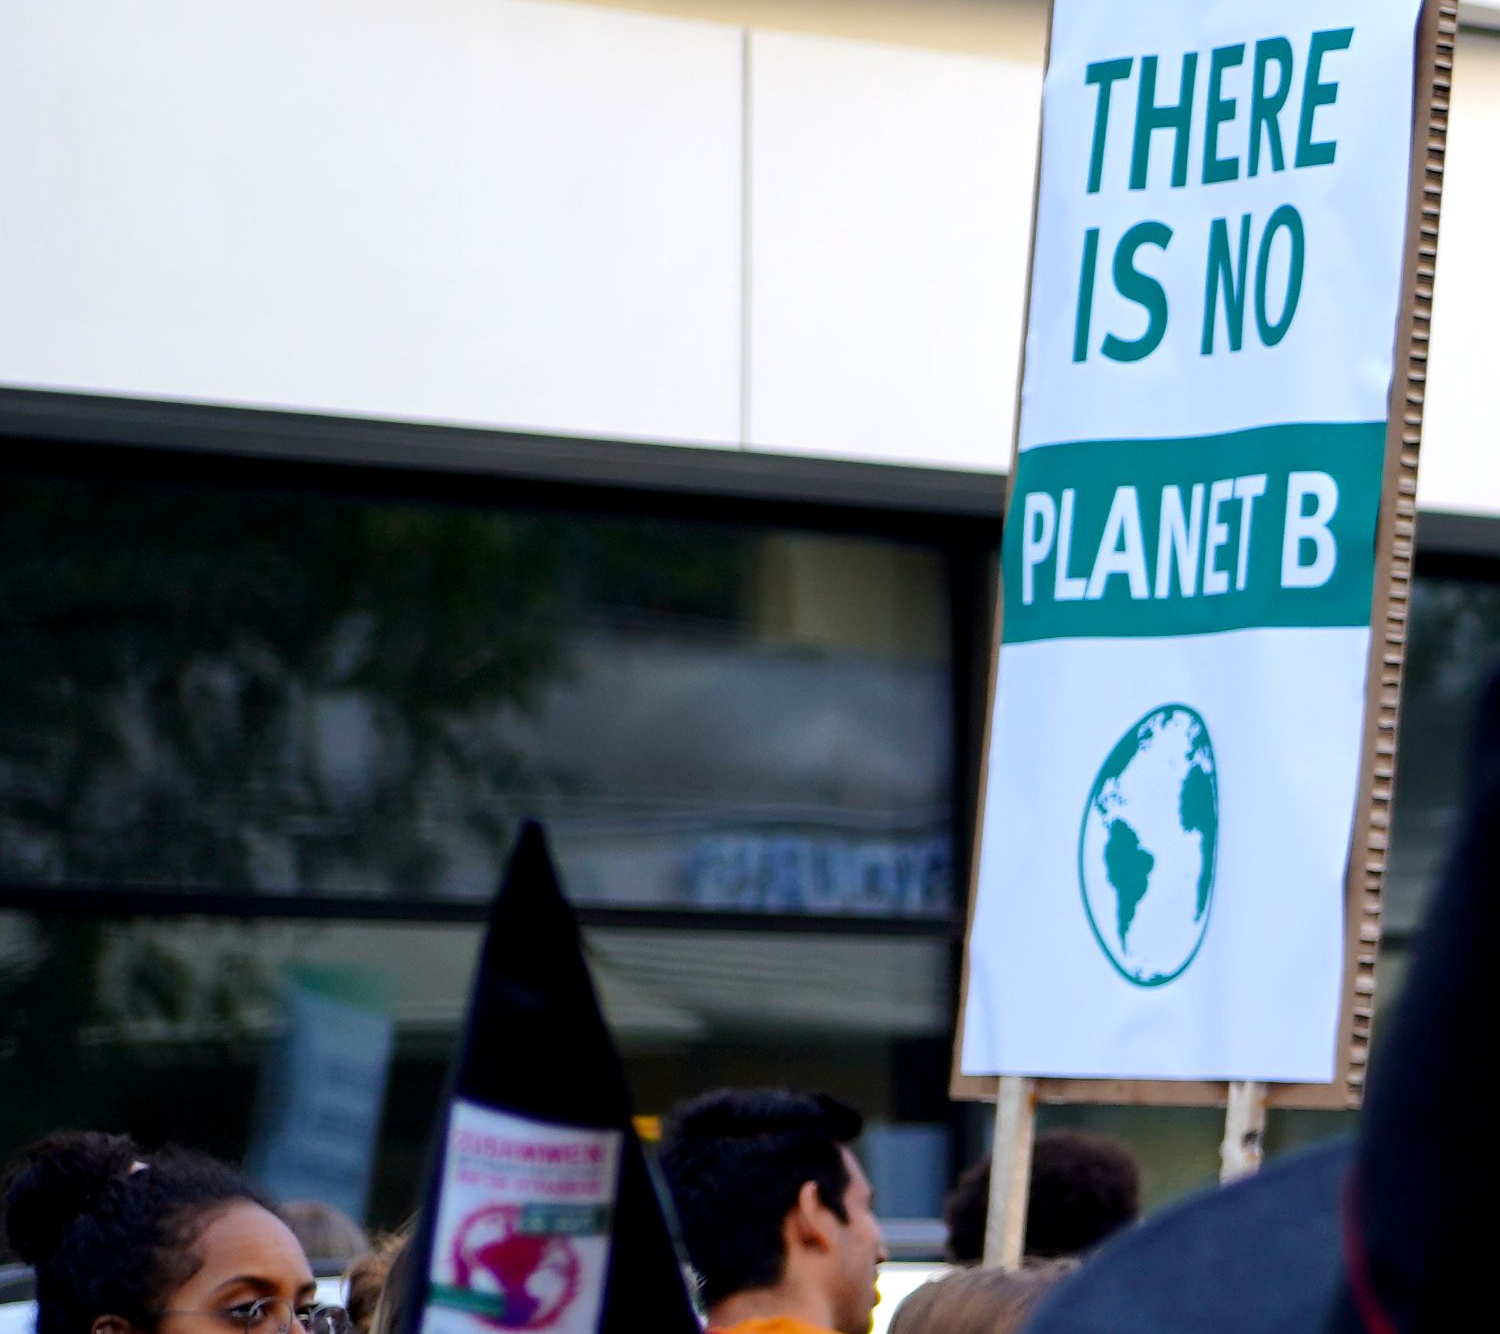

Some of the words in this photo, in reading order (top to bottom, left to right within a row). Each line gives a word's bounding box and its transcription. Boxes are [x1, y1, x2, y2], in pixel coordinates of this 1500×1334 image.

[1084, 26, 1357, 196] THERE
[1072, 219, 1175, 364] IS
[1200, 203, 1307, 357] NO
[1024, 475, 1266, 602] PLANET
[1282, 472, 1337, 586] B
